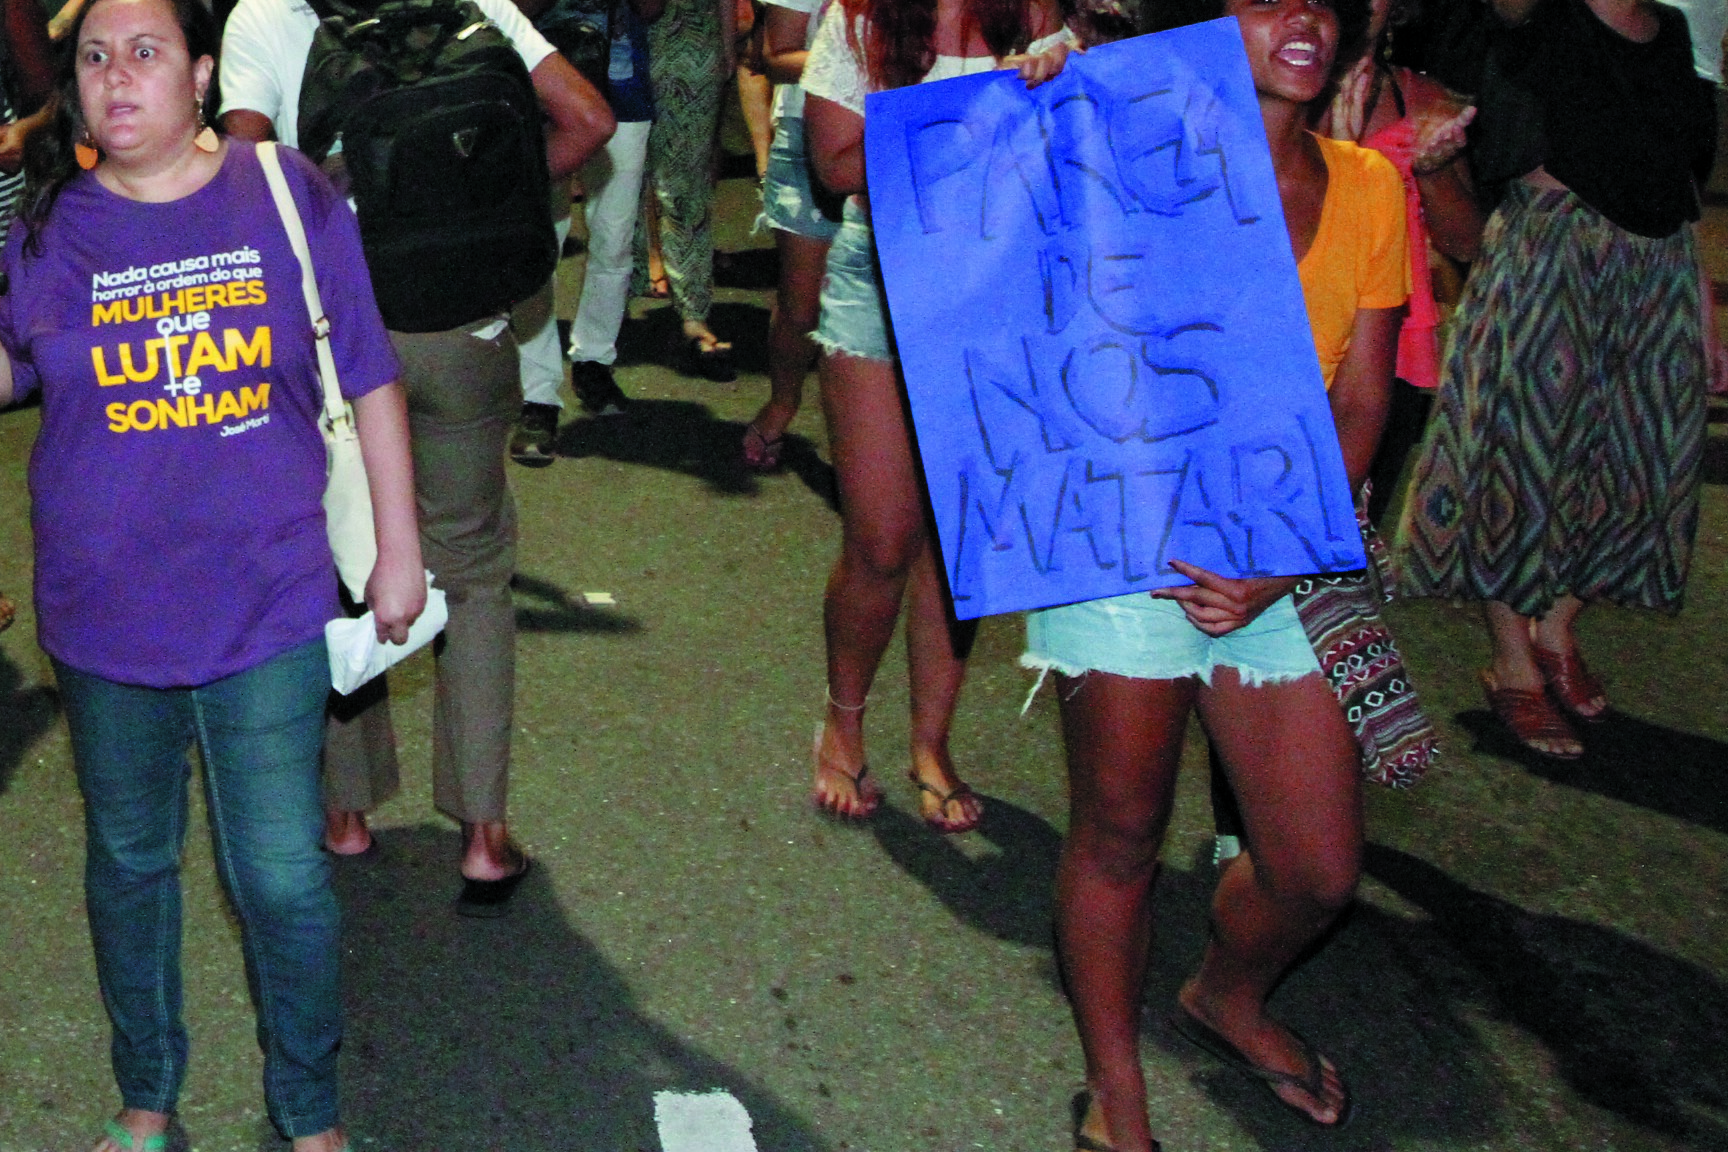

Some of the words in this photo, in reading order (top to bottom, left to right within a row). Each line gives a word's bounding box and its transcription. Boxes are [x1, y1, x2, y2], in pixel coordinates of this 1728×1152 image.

[92, 265, 148, 289] Nada
[149, 255, 209, 278] causa
[211, 245, 261, 267] mais
[92, 283, 142, 302] horror
[143, 279, 155, 294] à
[156, 270, 208, 292] ordem
[209, 267, 231, 282] do
[232, 266, 263, 284] que
[91, 280, 267, 327] MULHERES
[1037, 248, 1158, 338] DE
[156, 311, 211, 336] que
[91, 326, 271, 387] LUTAM
[105, 383, 270, 433] SONHAM
[964, 322, 1224, 476] NOS
